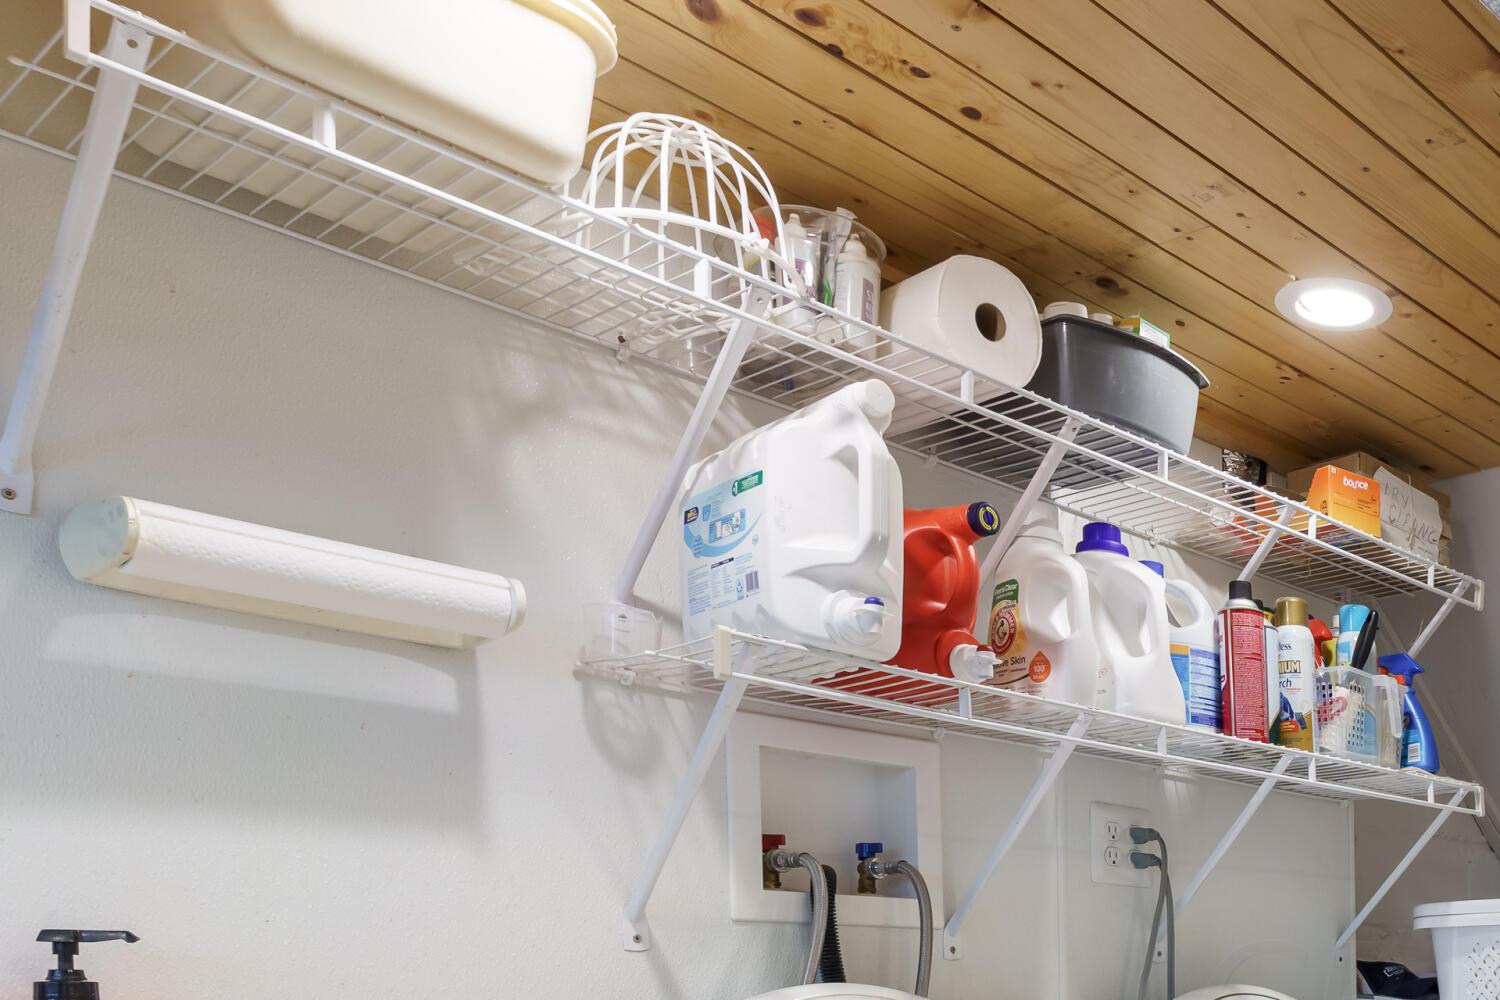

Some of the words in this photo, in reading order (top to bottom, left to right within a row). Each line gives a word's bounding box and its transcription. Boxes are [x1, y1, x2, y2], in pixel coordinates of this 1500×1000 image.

[1343, 476, 1369, 490] bounce
[1010, 656, 1026, 666] Skin
[1279, 660, 1302, 674] IUM
[1279, 678, 1292, 688] rch
